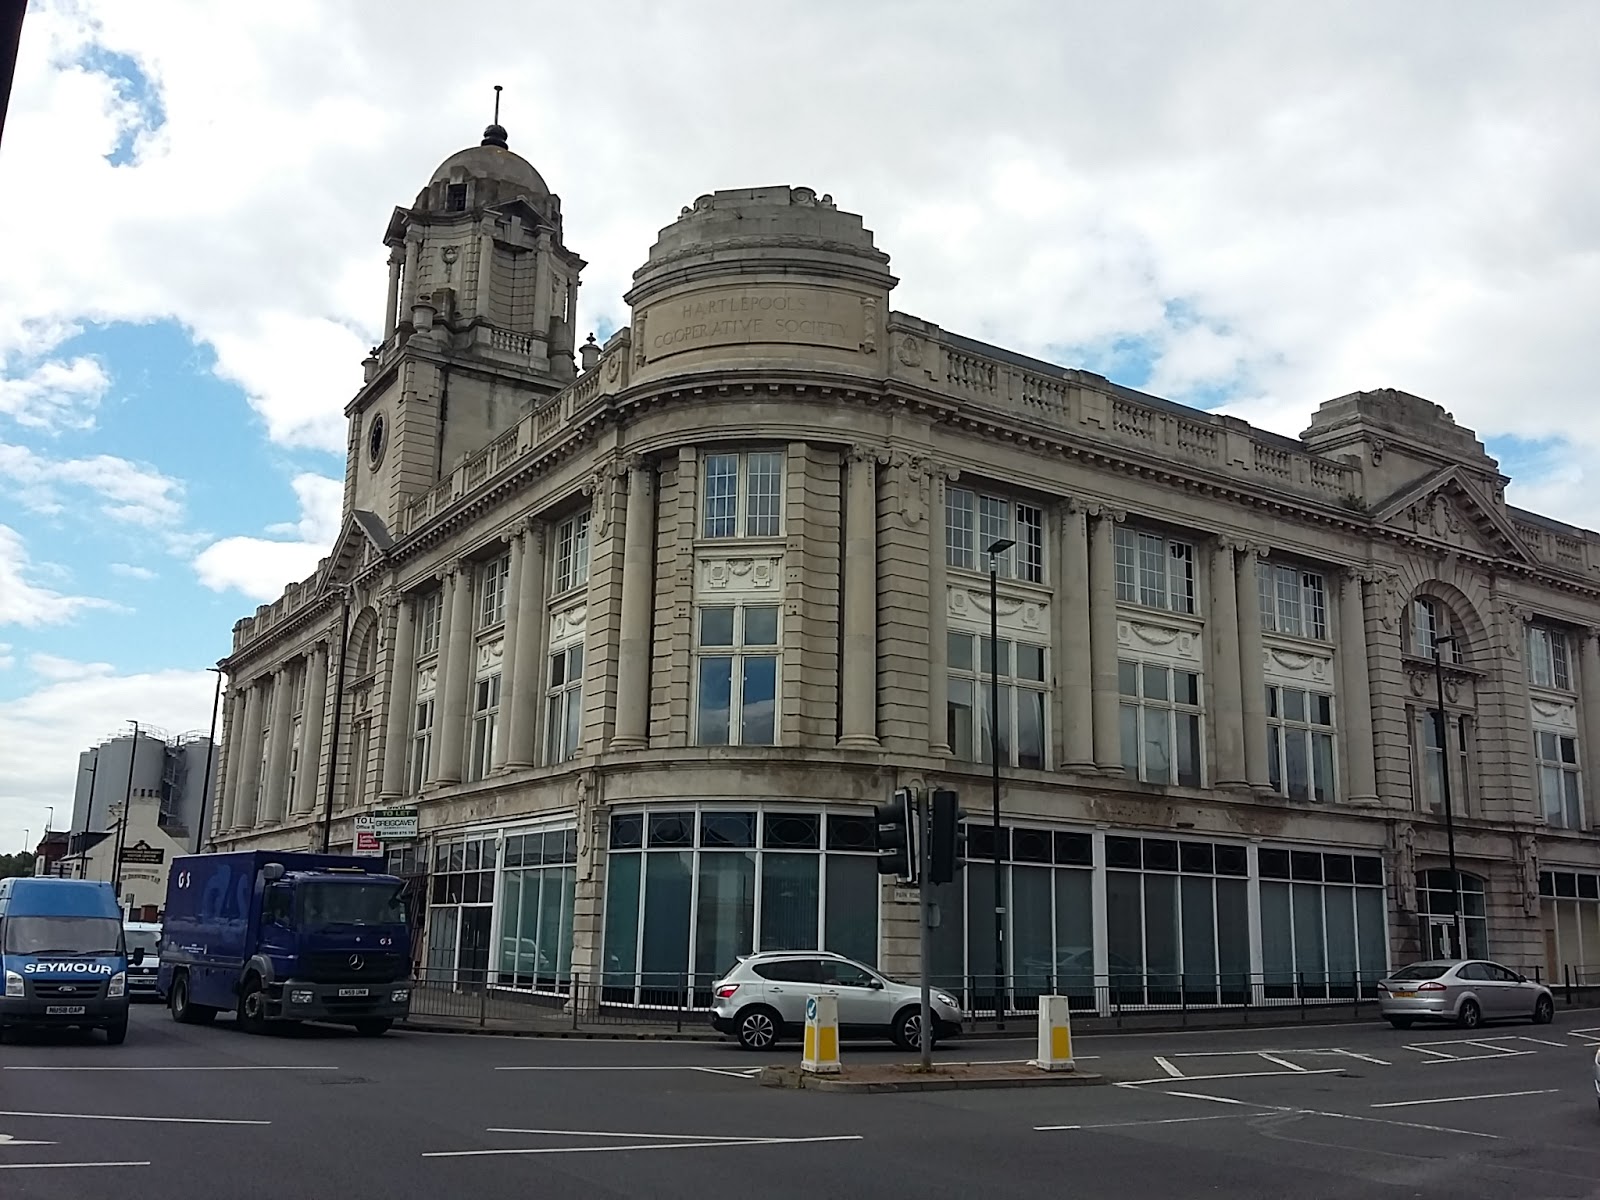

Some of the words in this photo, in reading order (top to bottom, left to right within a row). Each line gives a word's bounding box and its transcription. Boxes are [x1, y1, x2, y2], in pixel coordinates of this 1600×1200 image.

[683, 297, 806, 318] HARTLEPOOLS
[653, 318, 763, 349] COOPERATIVE
[775, 319, 849, 338] SOCIETY
[24, 962, 112, 975] SEYMOUR
